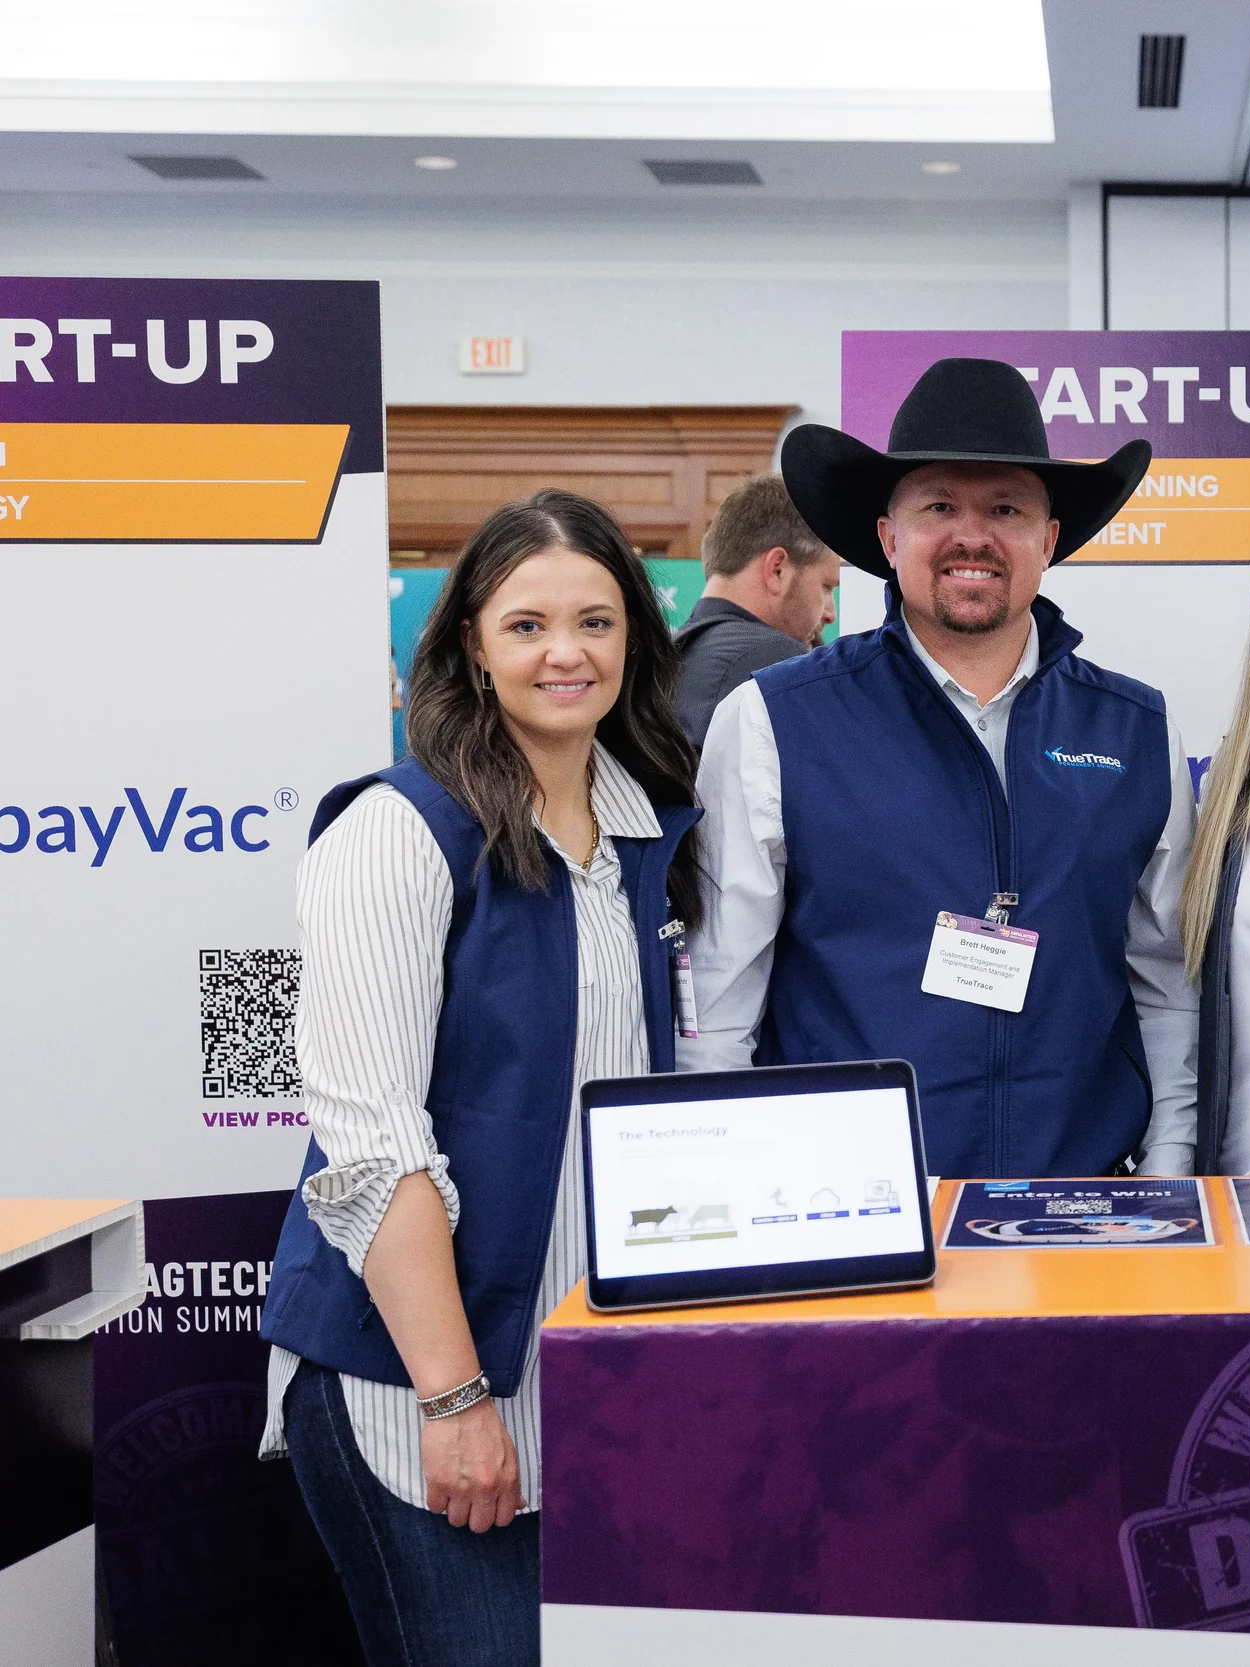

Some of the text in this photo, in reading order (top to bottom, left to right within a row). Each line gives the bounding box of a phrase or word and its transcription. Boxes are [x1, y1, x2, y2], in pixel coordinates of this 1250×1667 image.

[471, 337, 512, 367] EXIT
[960, 939, 1007, 956] Brett Heggie
[939, 949, 1020, 973] Customer Engagement and
[941, 957, 1015, 980] Implementation Manager
[956, 976, 994, 991] TrueTrace
[202, 1111, 310, 1128] VIEW PRO
[618, 1126, 729, 1141] The Technology
